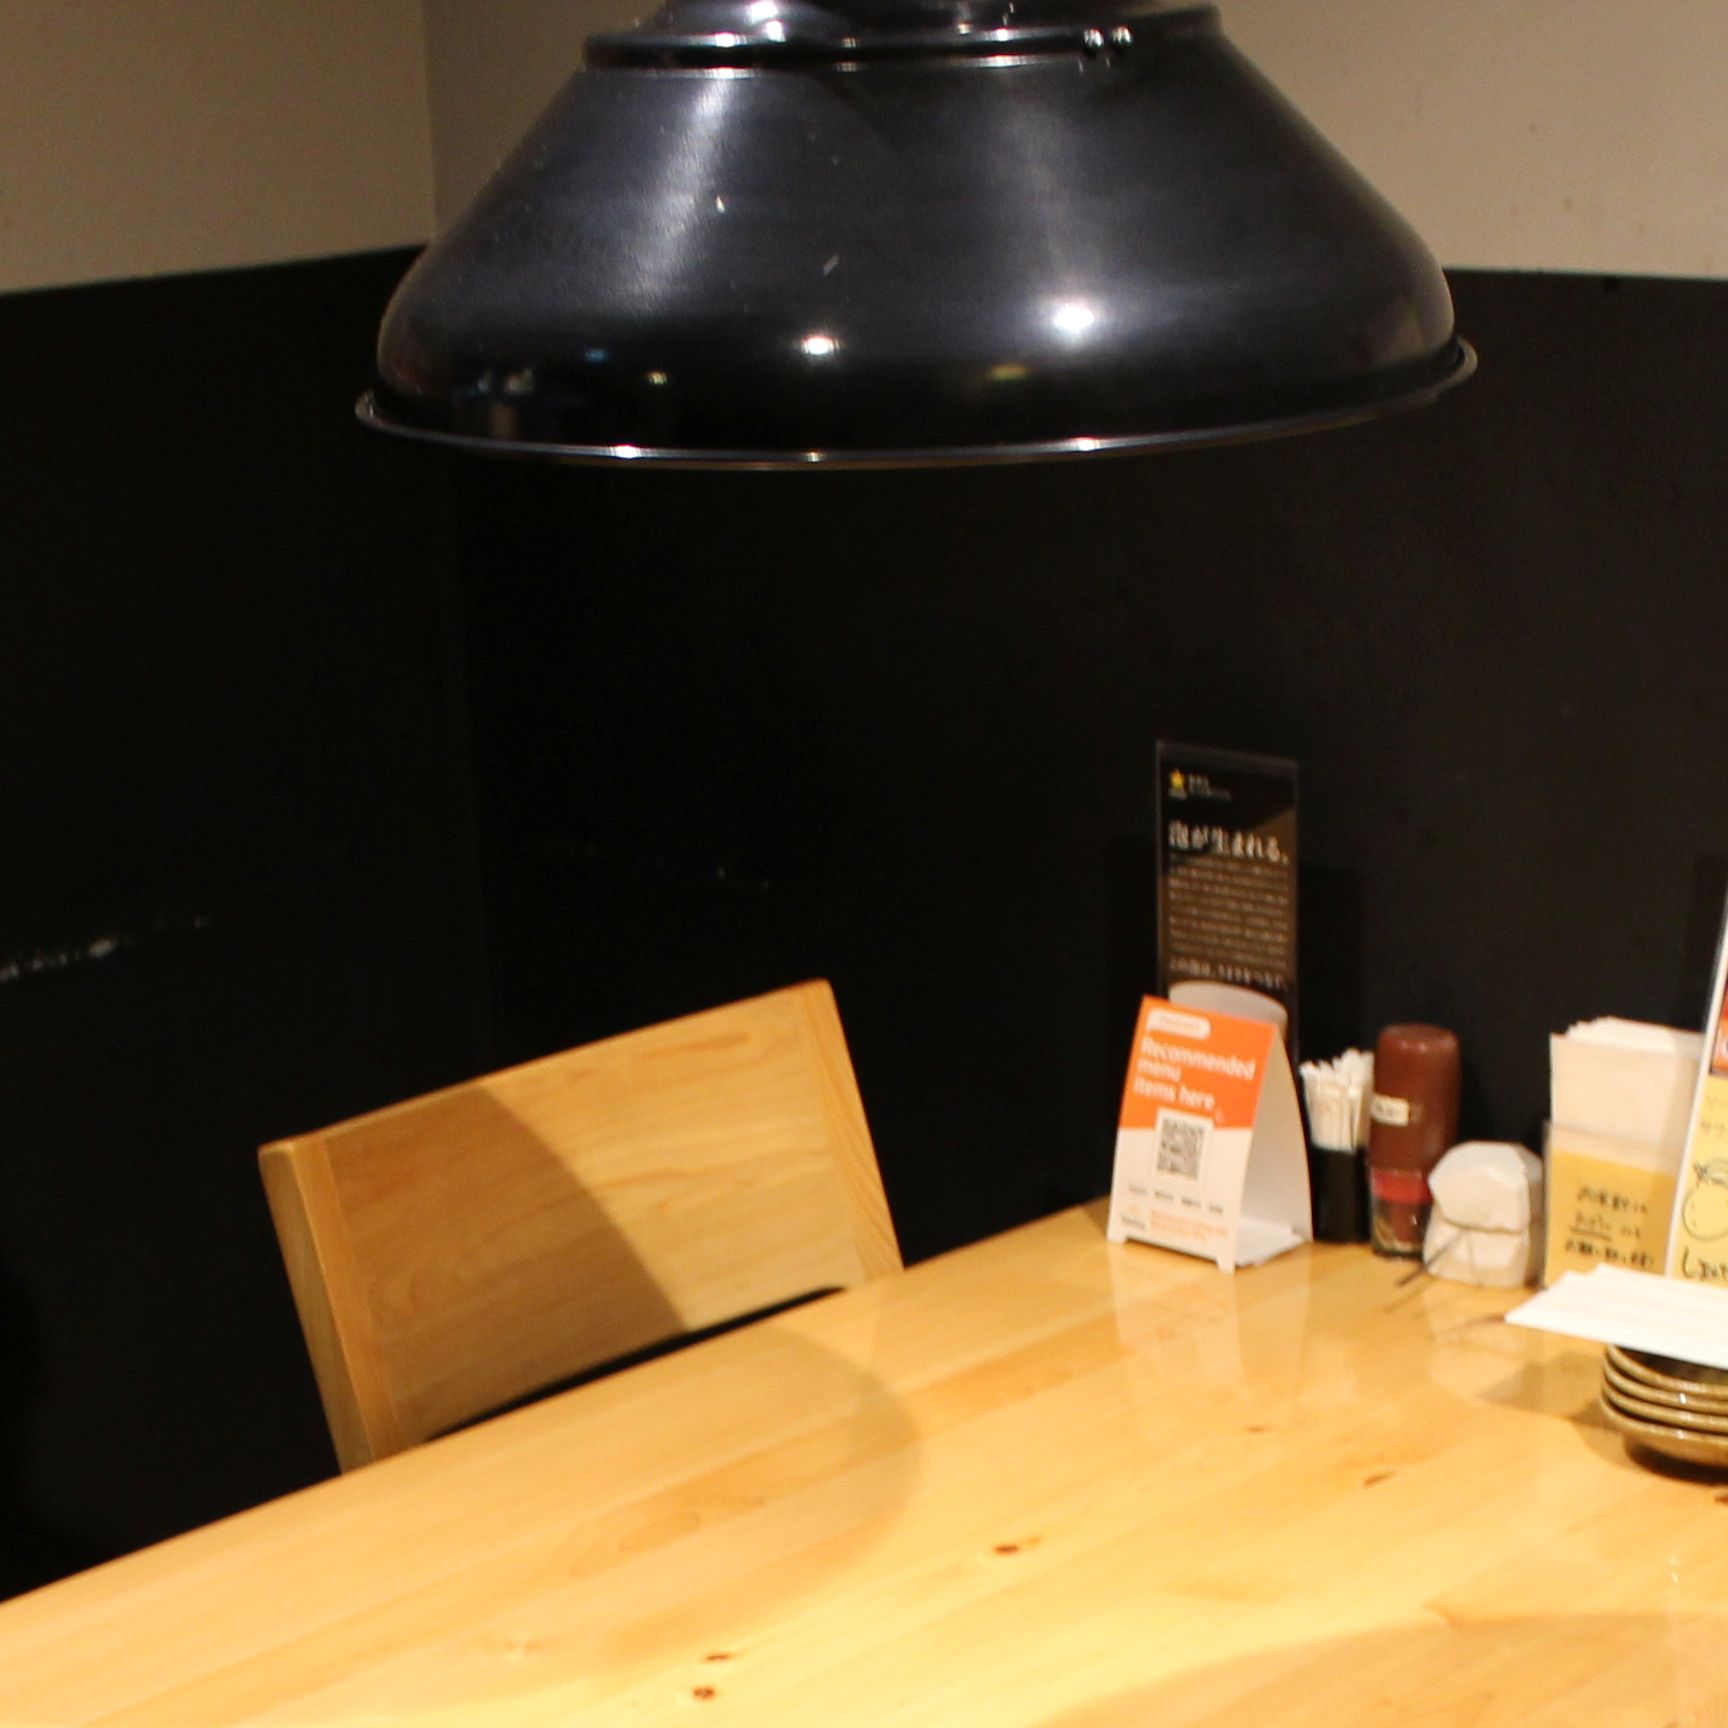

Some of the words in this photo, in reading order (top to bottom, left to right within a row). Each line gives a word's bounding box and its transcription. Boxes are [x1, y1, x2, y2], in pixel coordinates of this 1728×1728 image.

[1138, 1057, 1182, 1082] menu
[1141, 1036, 1256, 1081] Recommended
[1133, 1076, 1177, 1100] items
